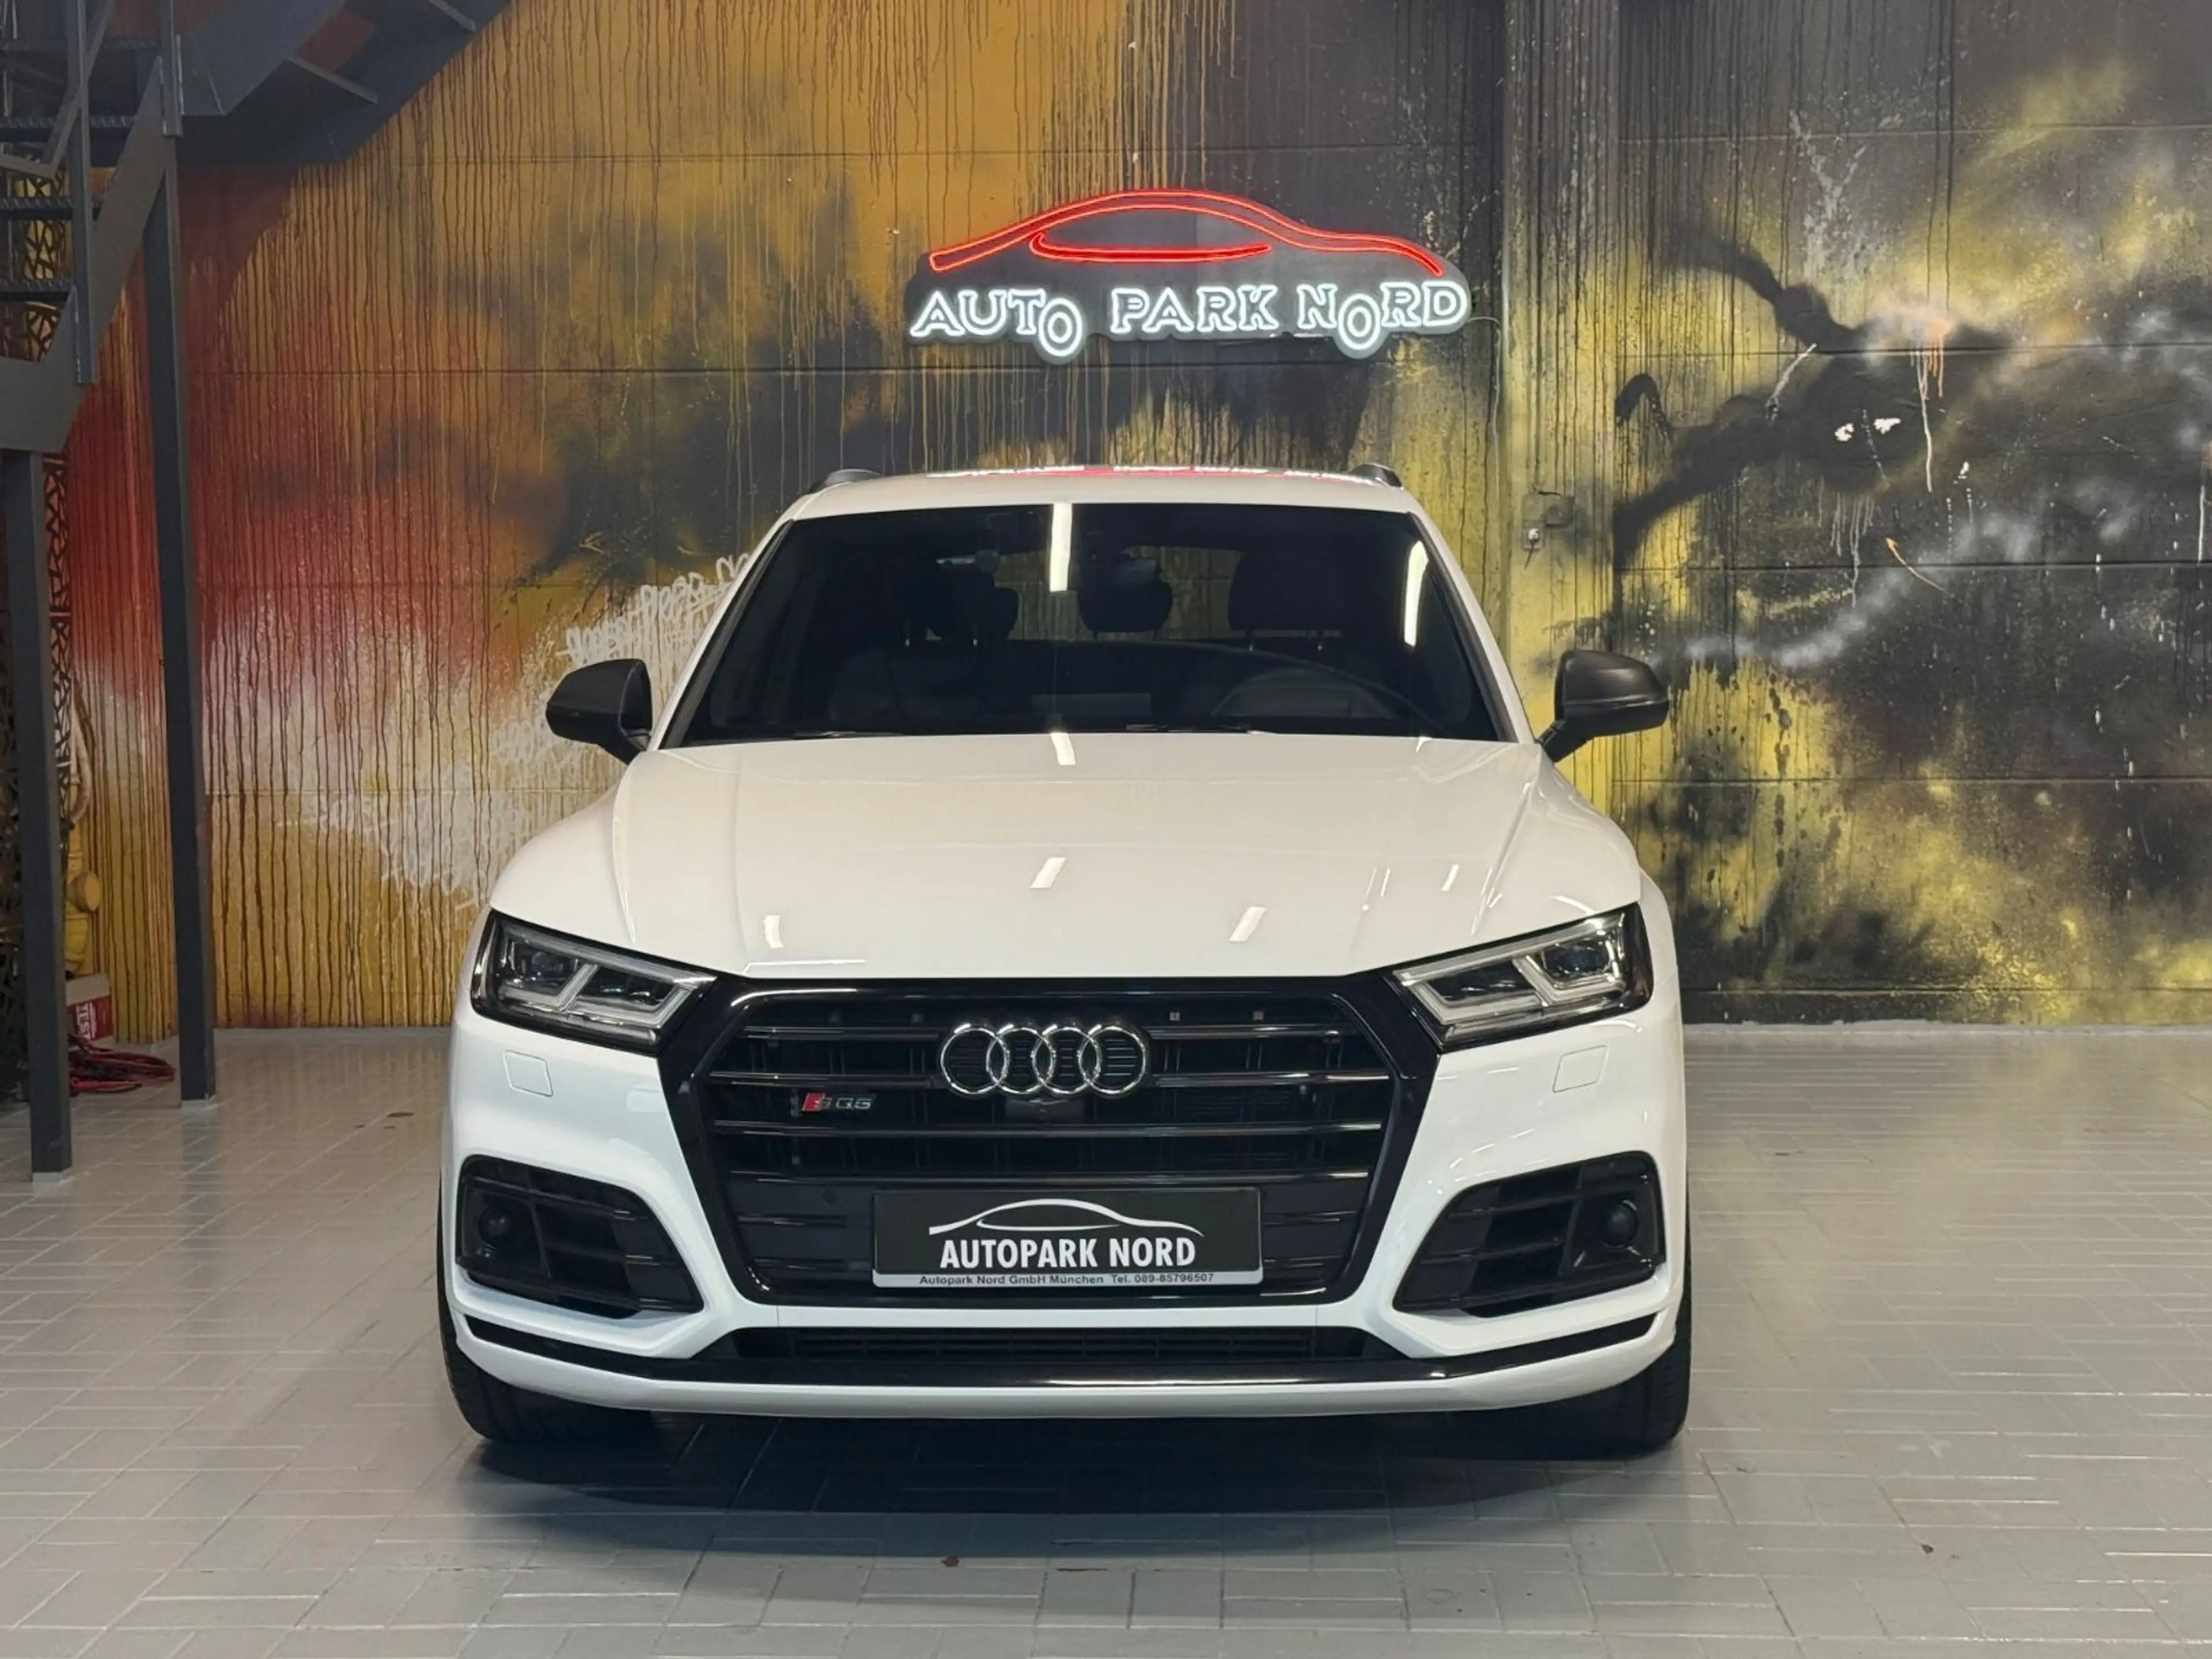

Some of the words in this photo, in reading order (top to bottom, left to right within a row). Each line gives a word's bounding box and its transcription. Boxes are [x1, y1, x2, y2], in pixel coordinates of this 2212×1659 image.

[910, 288, 1084, 357] AUTO
[1111, 284, 1279, 333] PARK
[1296, 281, 1469, 354] NORD
[940, 1238, 1099, 1268] AUTOPARK
[1109, 1237, 1196, 1267] NORD
[919, 1275, 973, 1286] Autopark
[977, 1275, 1005, 1285] Nord
[1009, 1274, 1046, 1284] GmbH
[1050, 1273, 1104, 1284] München
[1111, 1274, 1131, 1283] Tel.
